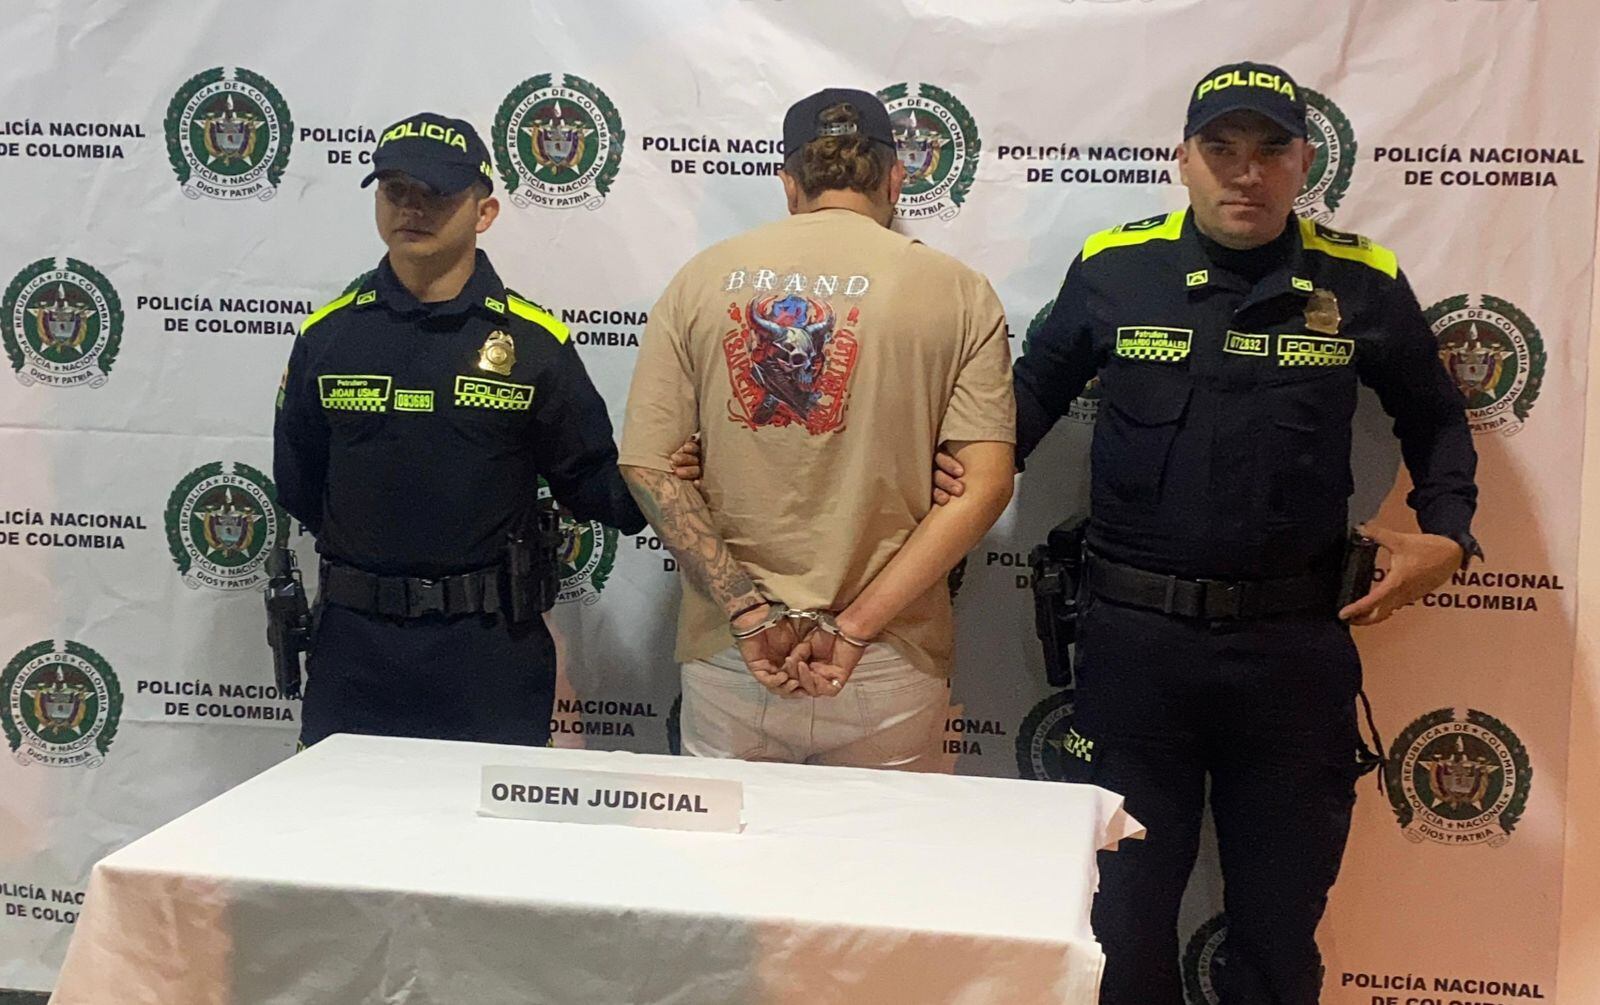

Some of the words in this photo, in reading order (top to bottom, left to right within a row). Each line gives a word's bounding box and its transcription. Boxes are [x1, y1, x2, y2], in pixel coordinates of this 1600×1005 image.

[1197, 69, 1296, 102] POLICÍA
[181, 87, 213, 140] REPUBLICA
[224, 82, 239, 90] DE
[248, 88, 278, 142] COLOMBIA
[509, 93, 541, 148] REPUBLICA
[551, 89, 566, 97] DE
[577, 96, 607, 150] COLOMBIA
[0, 118, 43, 136] ICÍA
[49, 122, 146, 138] NACIONAL
[300, 125, 376, 143] POLICÍA
[380, 121, 468, 153] POLICÍA
[907, 99, 921, 107] DE
[932, 105, 963, 160] COLOMBIA
[26, 143, 124, 159] COLOMBIA
[642, 134, 721, 153] POLICÍA
[727, 139, 785, 154] NACIO
[998, 143, 1081, 161] POLICÍA
[327, 150, 352, 164] DE
[1374, 144, 1462, 164] POLICÍA
[1470, 147, 1584, 165] NACIONAL
[230, 154, 274, 184] NACIONAL
[557, 162, 602, 193] NACIONAL
[671, 160, 696, 174] DE
[702, 160, 784, 176] COLOMB
[1027, 168, 1053, 183] DE
[1060, 168, 1172, 184] COLOMBIA
[196, 181, 220, 196] DIOS
[229, 183, 262, 197] PATRIA
[909, 172, 957, 204] NACIONAL
[1404, 171, 1433, 187] DE
[1440, 171, 1558, 188] COLOMBIA
[525, 189, 548, 204] DIOS
[548, 198, 554, 206] Y
[557, 191, 590, 206] PATRIA
[1296, 176, 1332, 206] CIONAL
[909, 202, 945, 216] PATRIA
[725, 269, 870, 296] BRAND
[55, 272, 70, 280] DE
[78, 278, 109, 331] COLOMBIA
[137, 294, 212, 312] POLICÍA
[220, 298, 314, 316] NACIONAL
[164, 318, 189, 332] DE
[195, 319, 296, 336] COLOMBIA
[562, 309, 648, 326] NACIONA
[576, 331, 639, 347] OMBIA
[1286, 341, 1347, 356] POLICÍA
[1467, 310, 1484, 319] DE
[1495, 317, 1527, 374] COLOMBIA
[62, 341, 105, 372] NACIONAL
[30, 368, 53, 383] DIOS
[62, 369, 93, 384] PATRIA
[463, 382, 526, 401] POLICÍA
[1469, 386, 1523, 418] NACIONAL
[222, 476, 236, 484] DE
[246, 483, 275, 536] COLOMBIA
[0, 508, 44, 525] ICÍA
[50, 512, 147, 530] NACIONAL
[26, 532, 125, 549] COLOMBIA
[228, 547, 271, 575] NACIONAL
[987, 552, 1033, 567] POLI
[196, 571, 218, 586] DIOS
[227, 574, 260, 588] PATRIA
[562, 560, 598, 588] ACIONAL
[1452, 572, 1564, 590] NACIONAL
[557, 587, 587, 600] ATRIA
[1423, 593, 1538, 611] COLOMBIA
[78, 661, 107, 713] COLOMBIA
[137, 679, 213, 697] POLICÍA
[219, 684, 292, 700] NACIO
[165, 702, 189, 716] DE
[196, 703, 294, 721] COLOMBIA
[557, 699, 658, 717] NACIONAL
[549, 719, 635, 737] OLOMBIA
[944, 718, 1006, 735] IONAL
[58, 723, 102, 751] NACIONAL
[1404, 727, 1442, 781] REPUBLICA
[1453, 724, 1469, 732] DE
[1480, 731, 1514, 788] COLOMBIA
[491, 783, 579, 806] ORDEN
[587, 789, 708, 814] JUDICIAL
[1456, 800, 1508, 829] NACIONAL
[1419, 824, 1445, 840] DIOS
[1445, 833, 1452, 842] Y
[1455, 828, 1494, 842] PATRIA
[0, 883, 47, 901] LICÍA
[6, 903, 27, 917] DE
[32, 907, 77, 924] COLO
[1341, 973, 1427, 992] POLICÍA
[1434, 978, 1545, 999] NACIONAL
